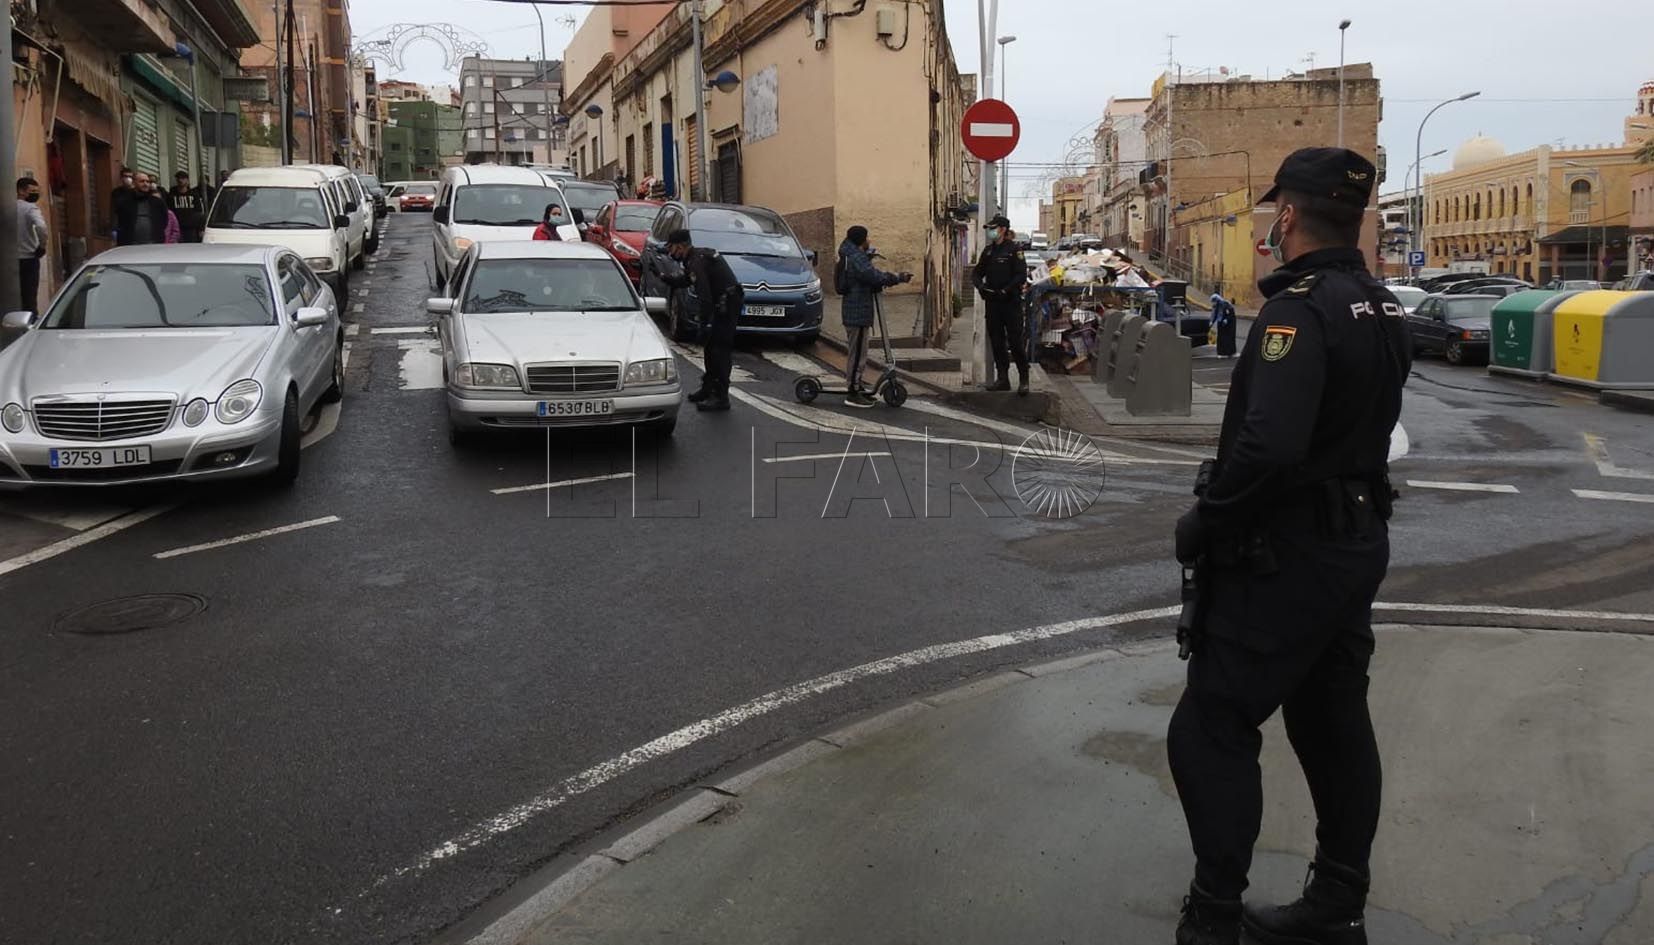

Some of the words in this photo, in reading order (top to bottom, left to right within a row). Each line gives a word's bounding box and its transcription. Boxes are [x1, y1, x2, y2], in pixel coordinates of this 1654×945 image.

[174, 195, 195, 209] LOVE
[747, 306, 766, 315] 4995
[548, 402, 582, 415] 6530
[585, 401, 609, 414] BLB
[61, 451, 102, 466] 3759
[113, 449, 146, 465] LDL
